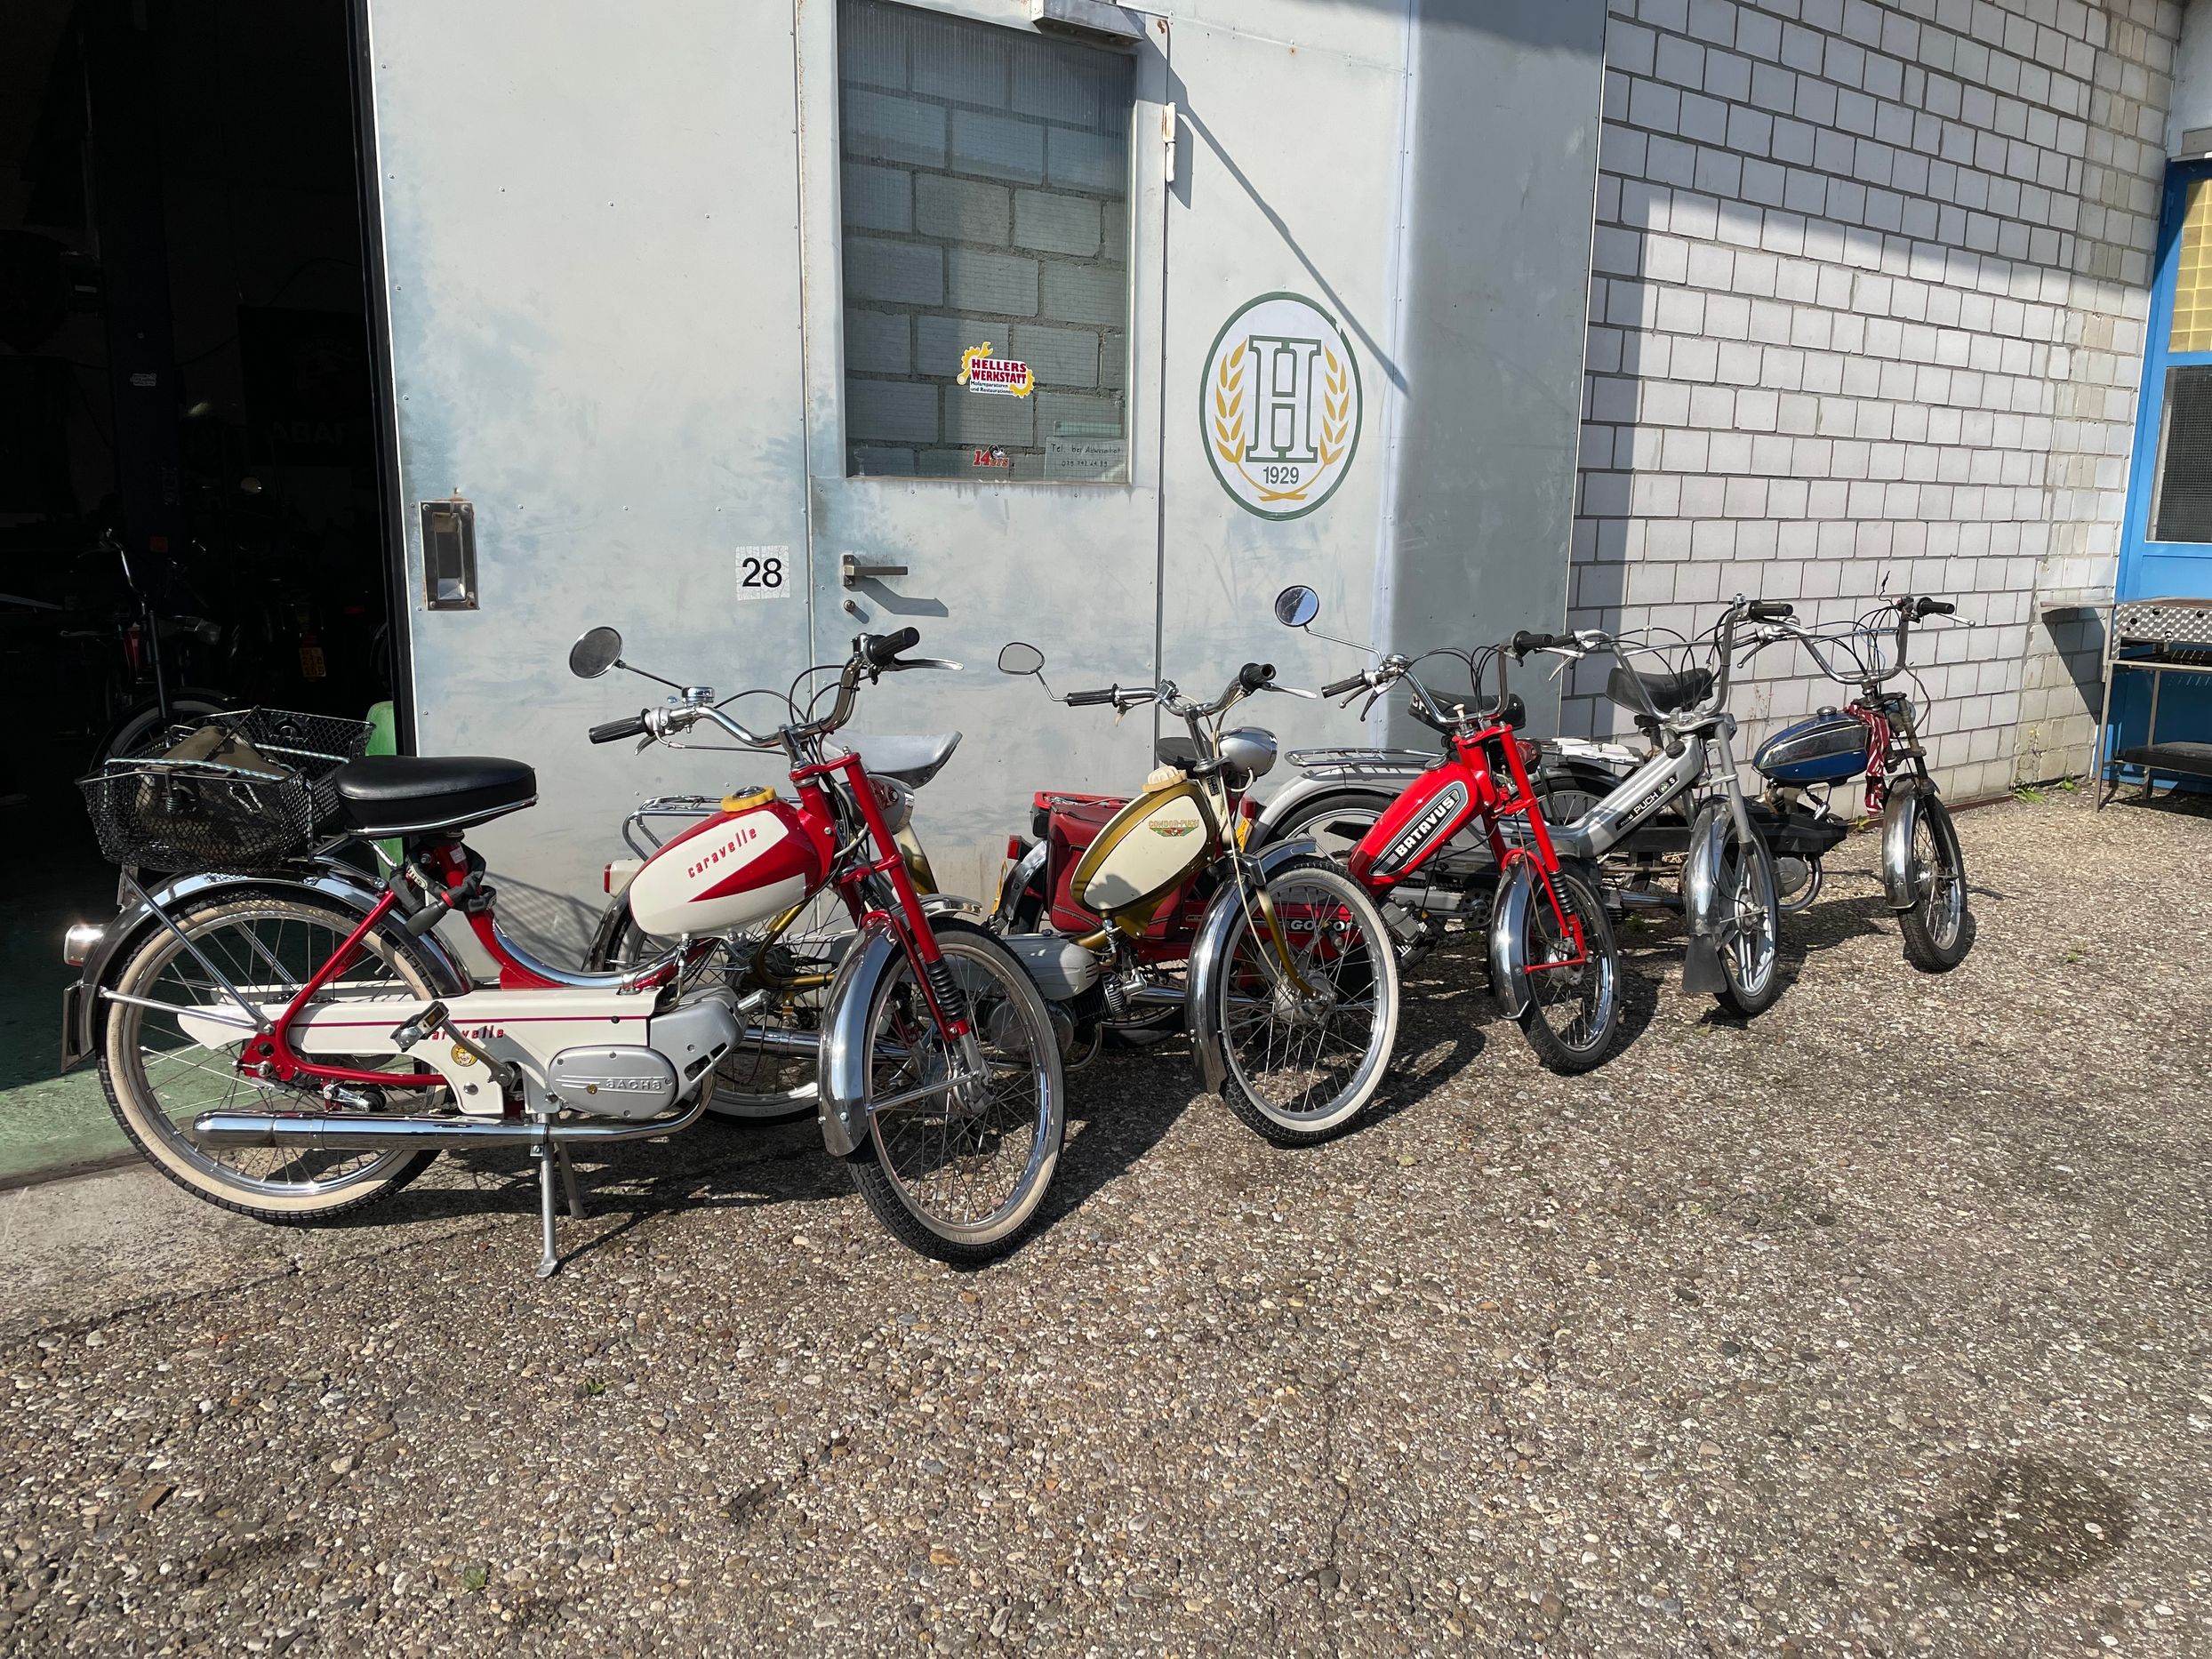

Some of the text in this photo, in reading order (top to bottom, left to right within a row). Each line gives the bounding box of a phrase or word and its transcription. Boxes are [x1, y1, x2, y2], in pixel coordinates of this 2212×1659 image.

[971, 358, 1027, 373] HELLERS
[971, 369, 1027, 385] WERKSTATT
[1262, 466, 1300, 485] 1929
[741, 557, 782, 588] 28
[1632, 791, 1659, 815] PUCH
[1668, 776, 1676, 785] S
[1394, 796, 1457, 857] BATAVUS
[687, 828, 757, 878] caravelle
[431, 1025, 505, 1040] arvelle
[605, 1078, 662, 1090] SACHS
